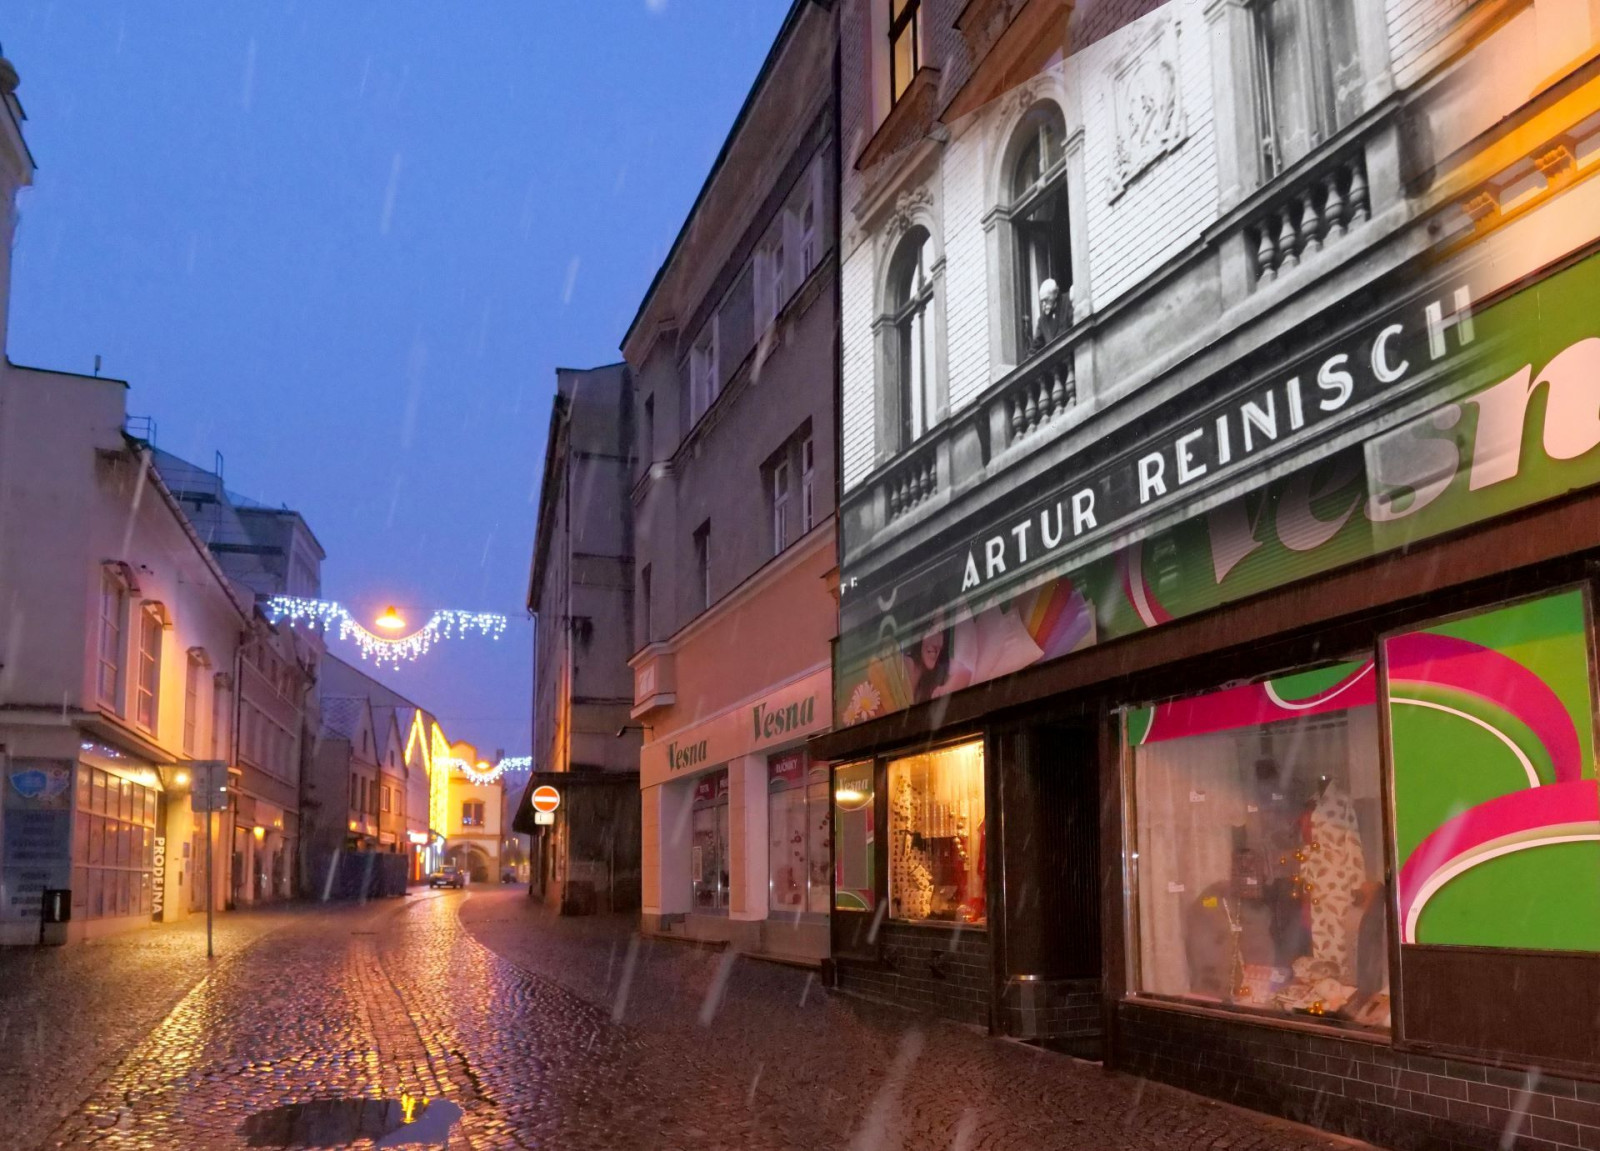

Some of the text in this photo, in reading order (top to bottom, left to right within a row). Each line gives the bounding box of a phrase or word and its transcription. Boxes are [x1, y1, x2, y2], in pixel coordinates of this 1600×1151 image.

[961, 284, 1475, 592] ARTUR REINISCH
[752, 695, 815, 742] Vesna
[668, 739, 708, 772] Vesna
[839, 777, 869, 792] Vesna
[151, 836, 166, 914] PRODEJNA
